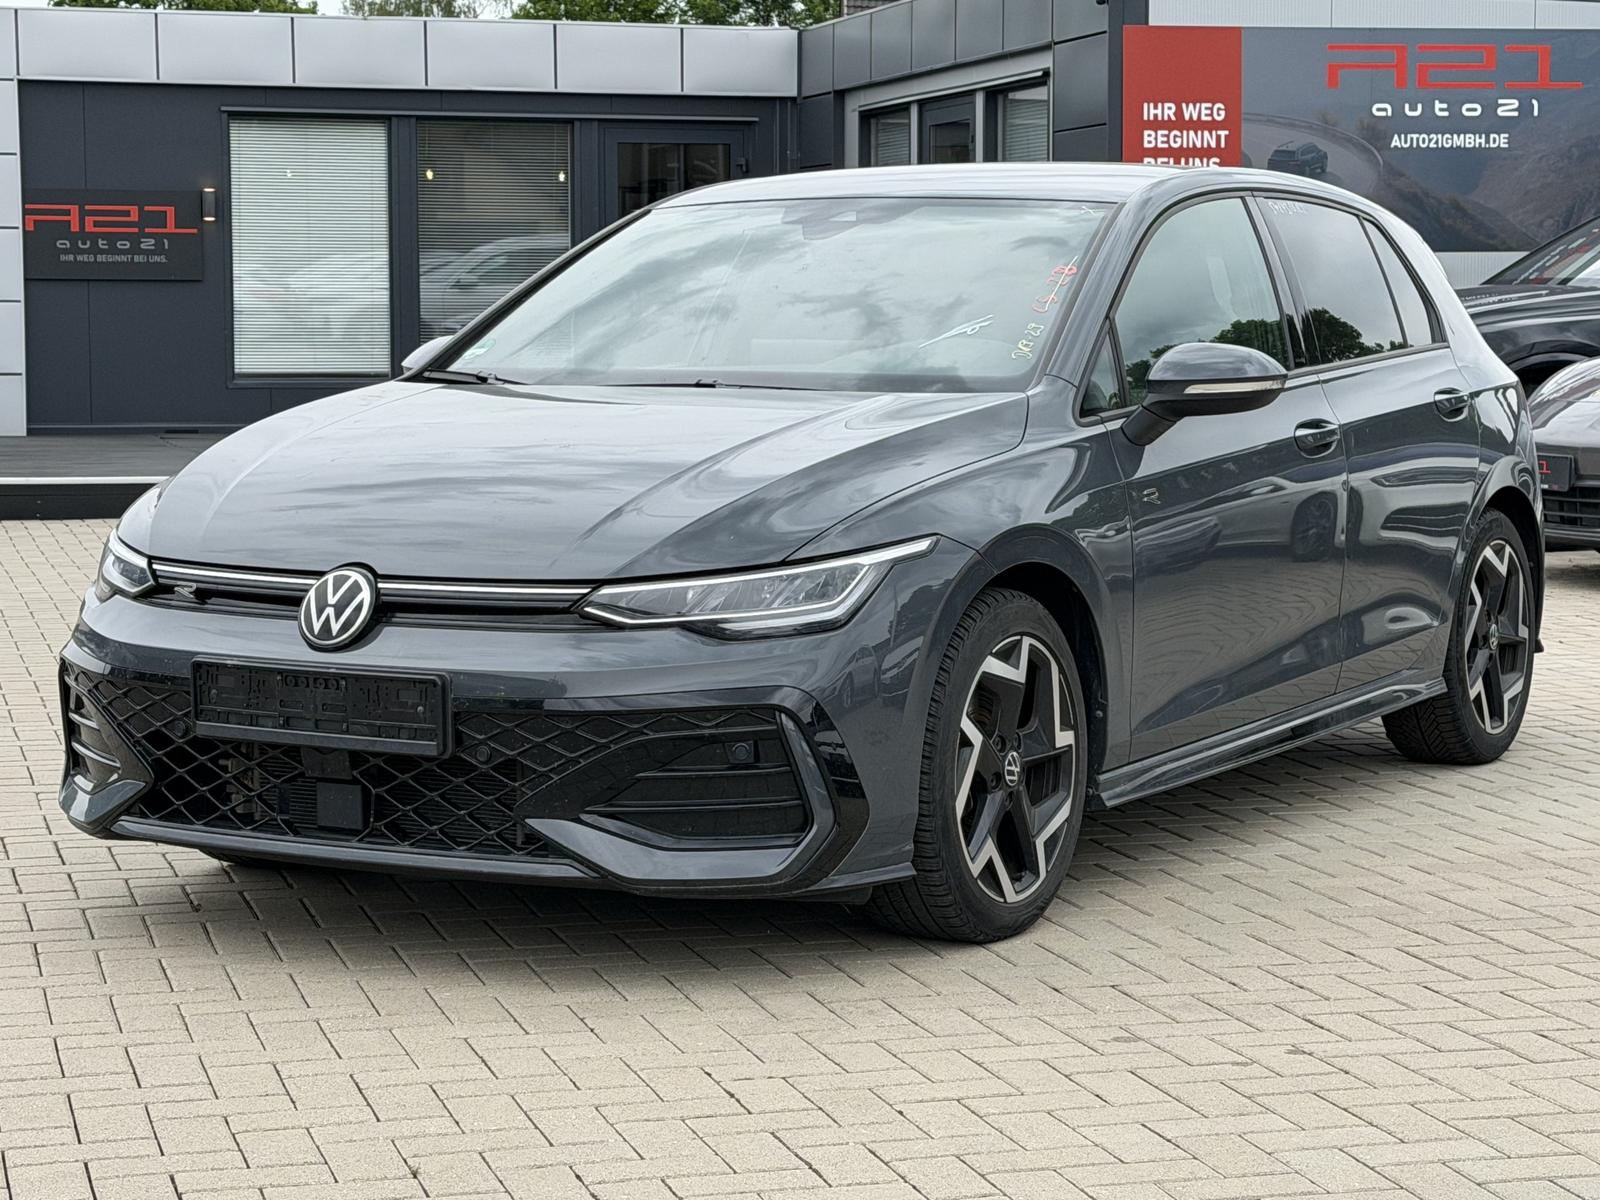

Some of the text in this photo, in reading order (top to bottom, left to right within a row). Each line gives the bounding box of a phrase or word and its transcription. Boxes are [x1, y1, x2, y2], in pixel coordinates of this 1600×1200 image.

[1327, 43, 1585, 89] A21
[1143, 102, 1226, 121] IHR WEG
[1371, 98, 1540, 118] auto21
[1143, 129, 1230, 149] BEGINNT
[1390, 133, 1510, 149] AUTO21GMBH.DE
[24, 203, 198, 234] A21
[56, 238, 169, 250] auto21
[59, 254, 169, 263] IHR WEG BEGINNT BEI UNS.
